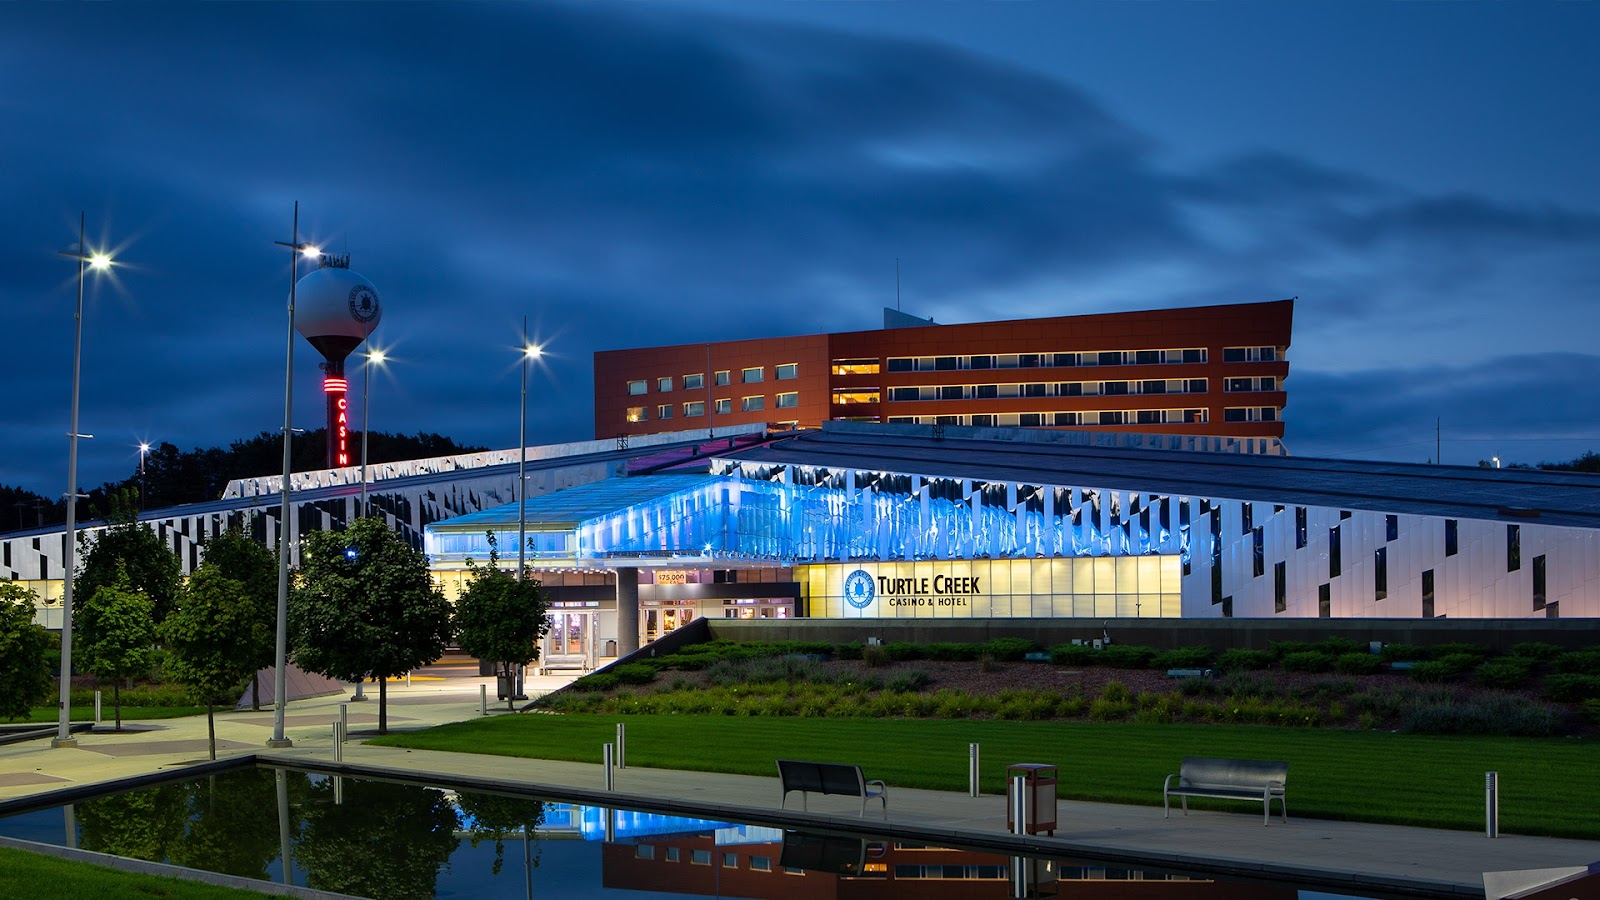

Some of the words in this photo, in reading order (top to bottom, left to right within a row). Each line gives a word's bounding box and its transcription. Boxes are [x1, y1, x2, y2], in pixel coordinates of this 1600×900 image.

[338, 398, 347, 468] CASIN
[878, 576, 928, 594] TURTLE
[934, 575, 980, 594] CREEK
[889, 598, 925, 606] CASINO
[927, 598, 934, 607] &
[938, 597, 967, 606] HOTEL
